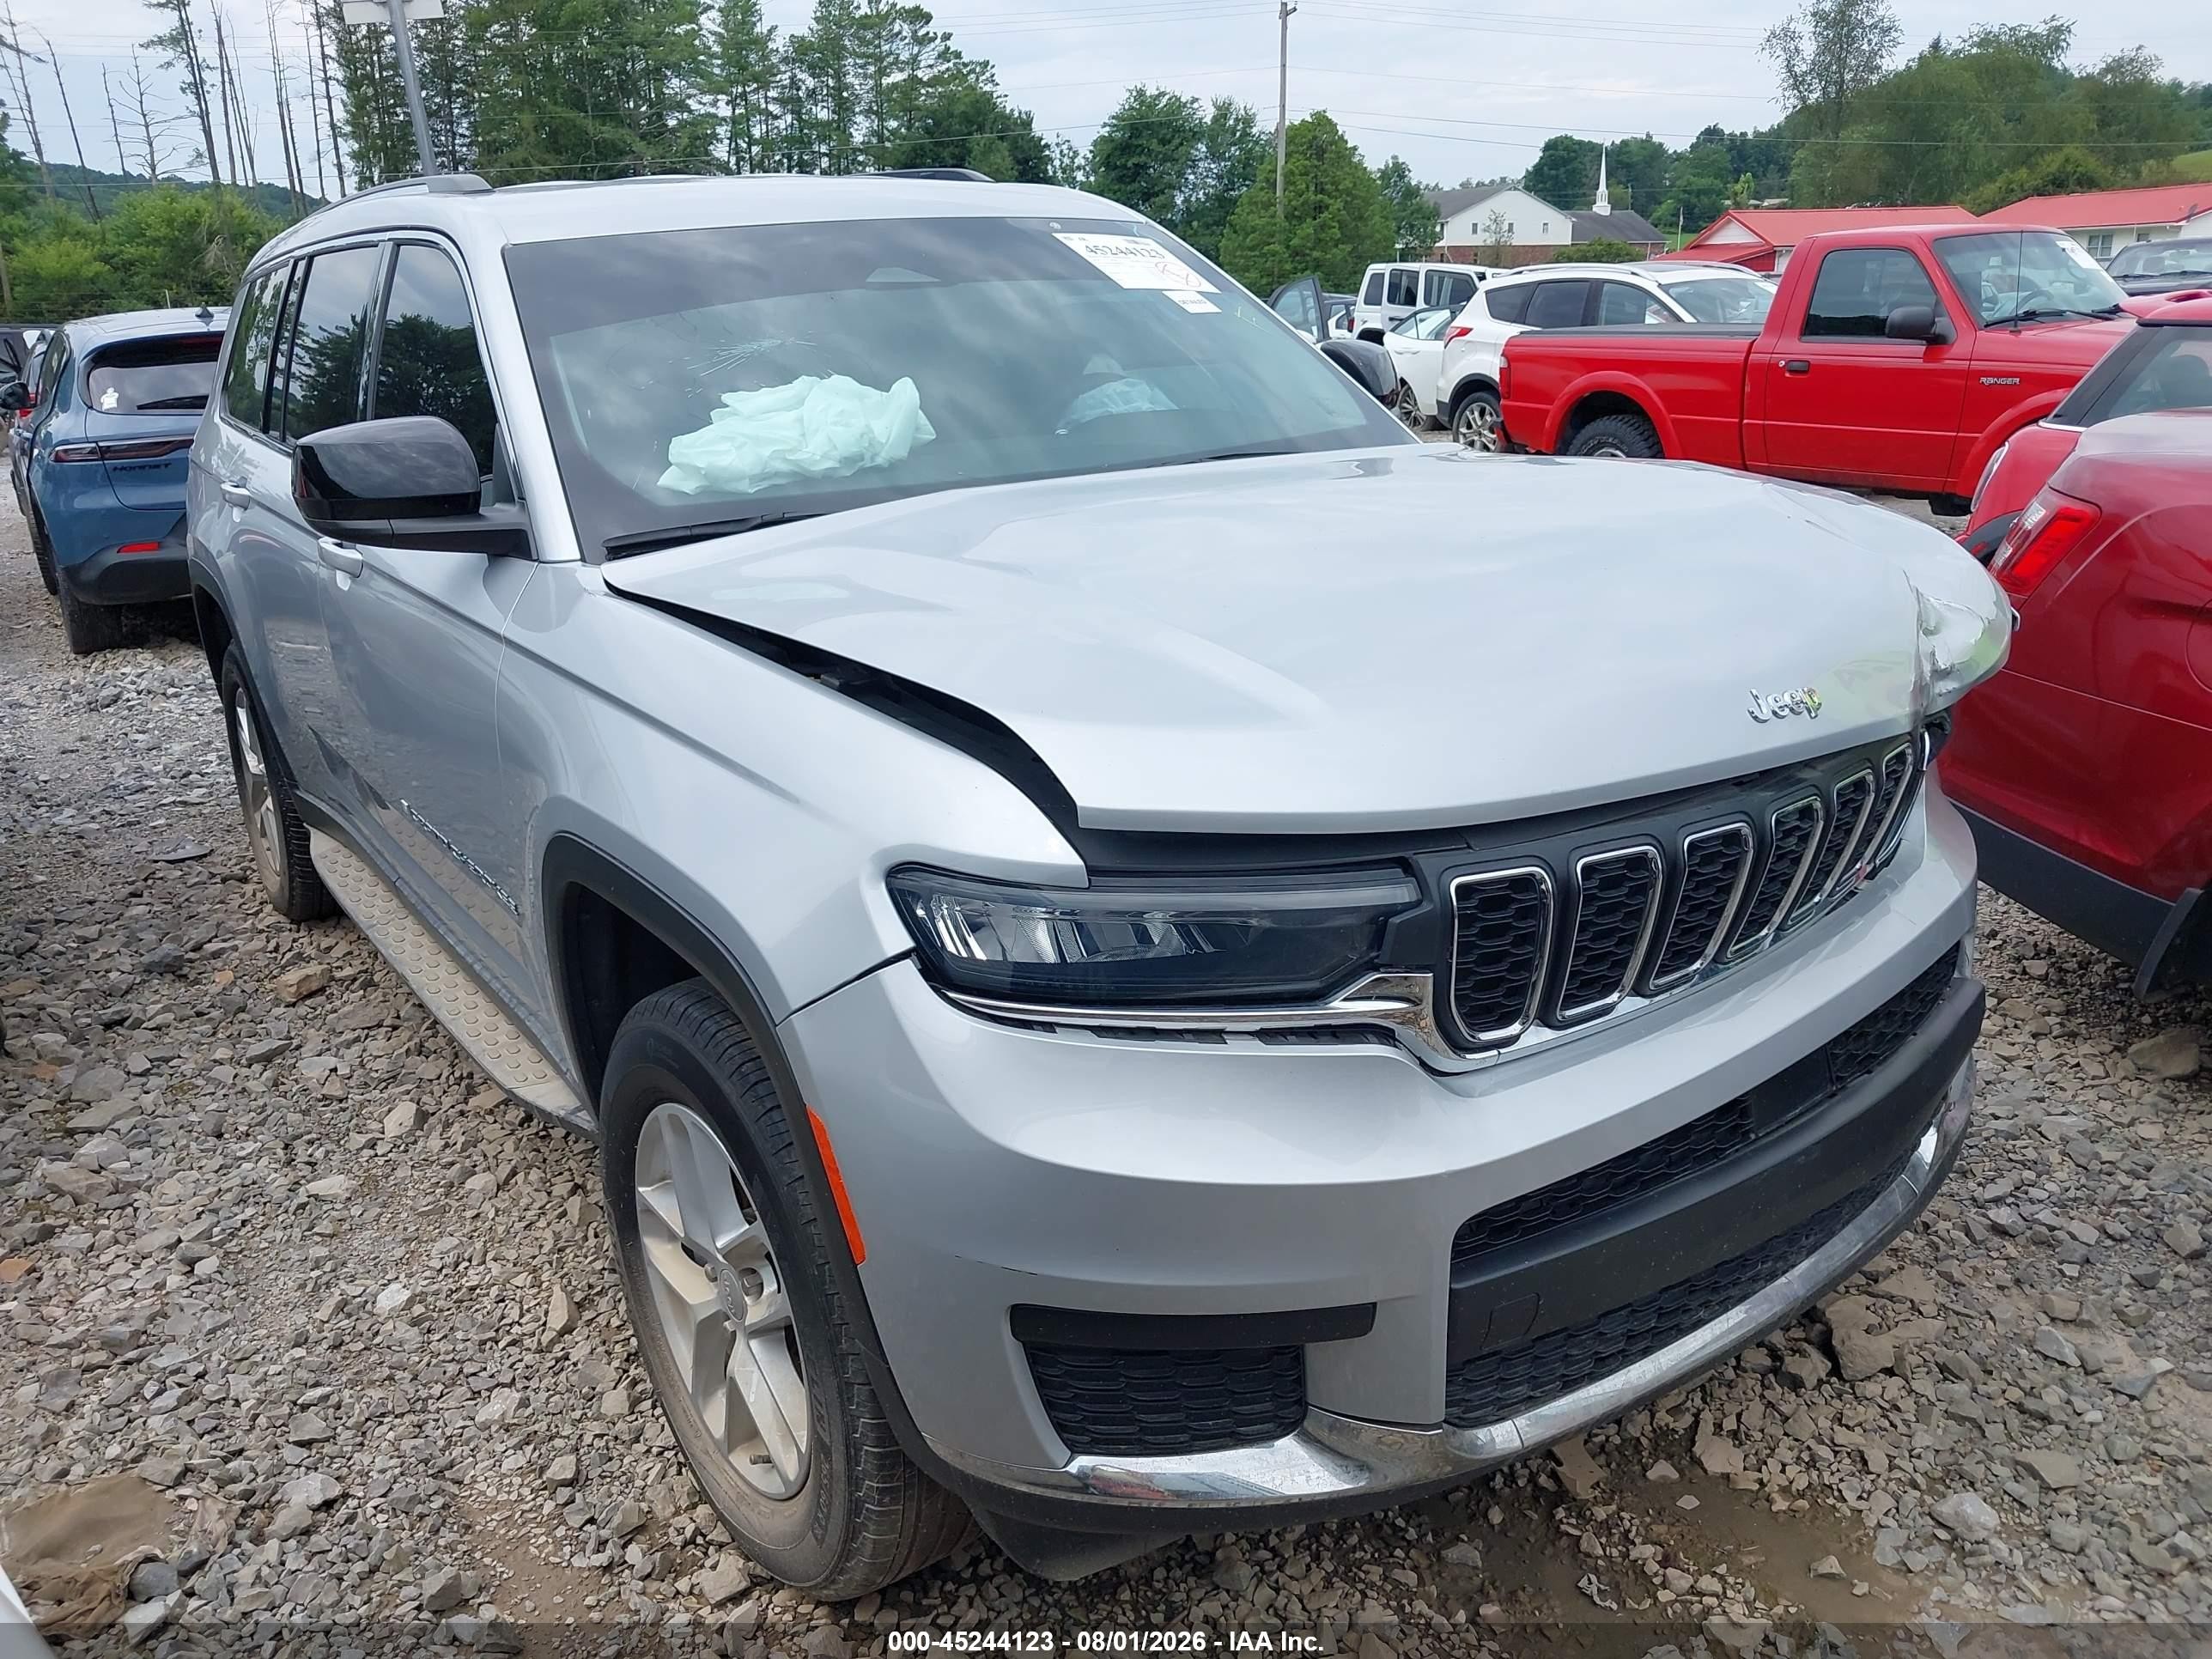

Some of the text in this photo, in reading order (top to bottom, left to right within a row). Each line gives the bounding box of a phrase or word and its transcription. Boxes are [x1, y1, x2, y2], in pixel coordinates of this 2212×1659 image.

[1085, 244, 1165, 260] 45244123
[1979, 377, 2020, 386] RANGER
[1747, 687, 1822, 724] Jeep
